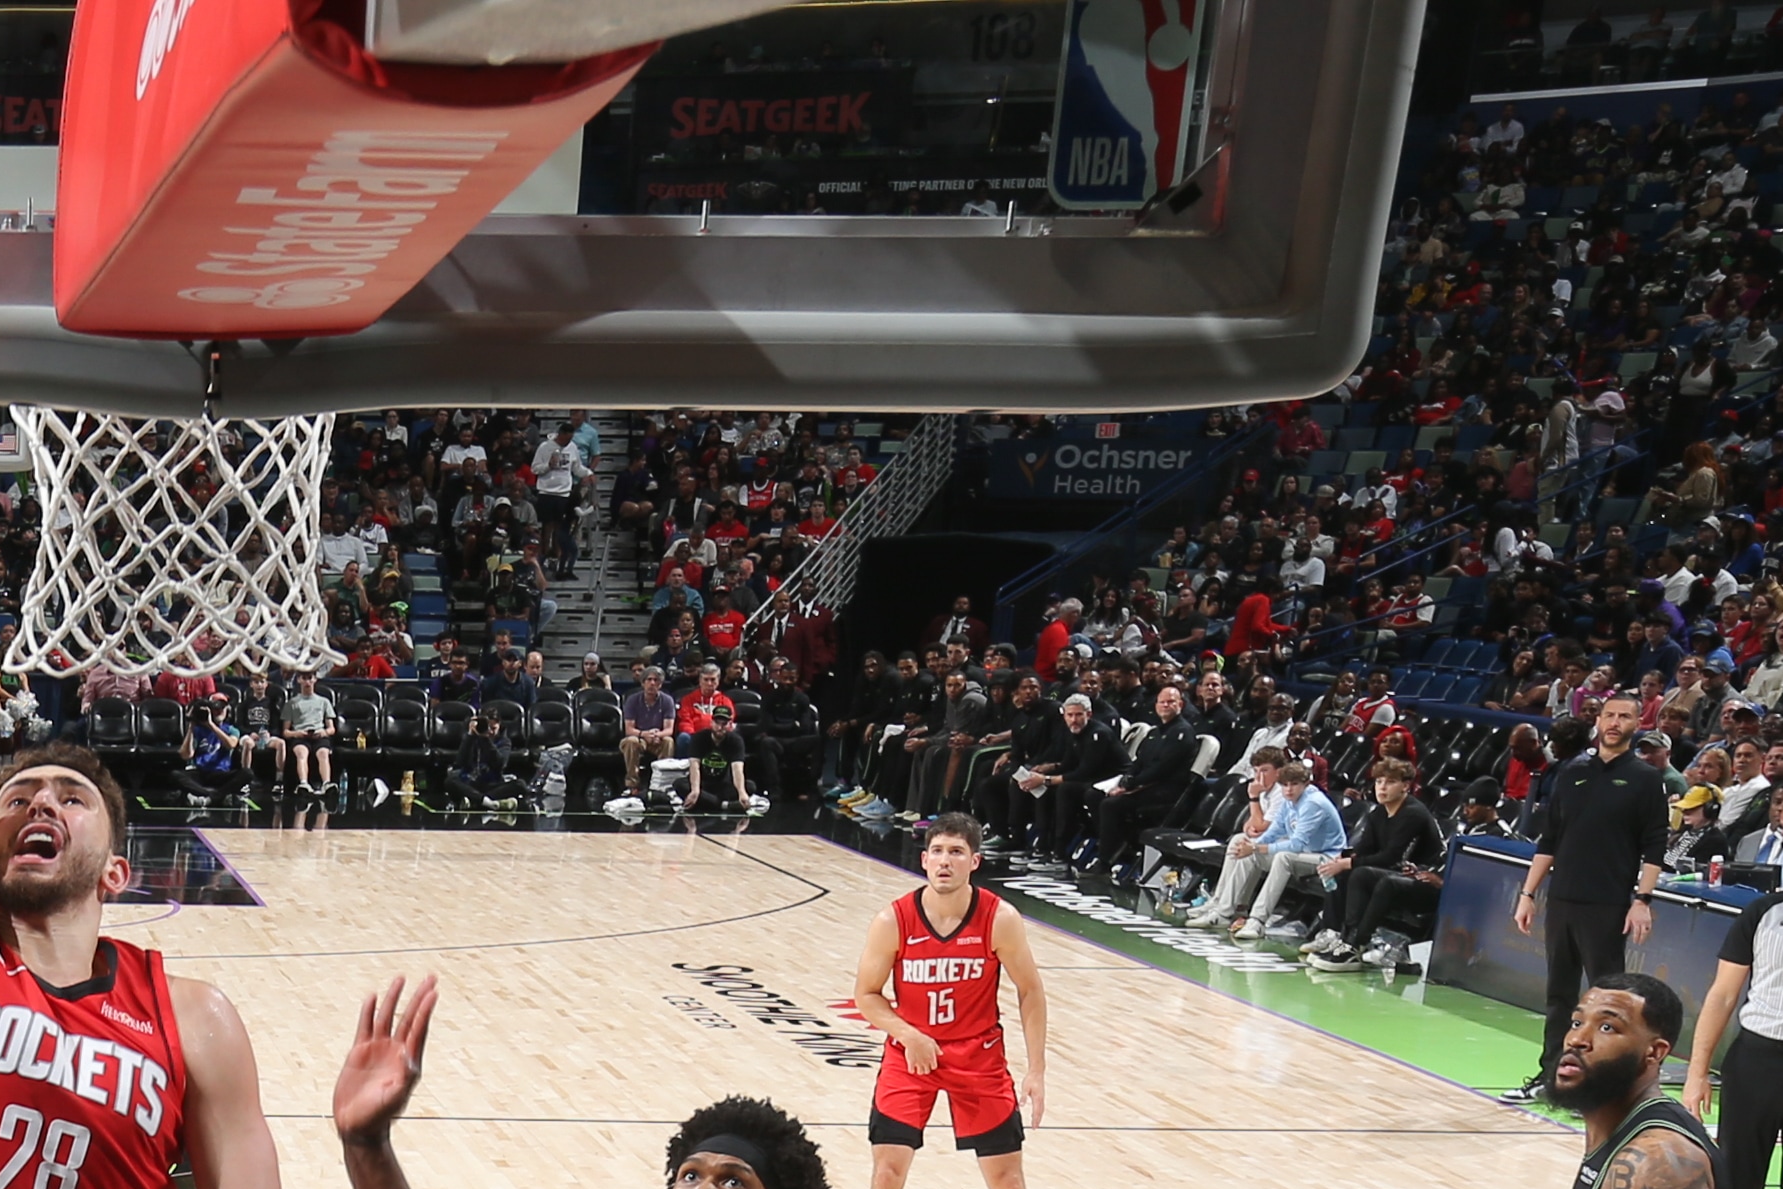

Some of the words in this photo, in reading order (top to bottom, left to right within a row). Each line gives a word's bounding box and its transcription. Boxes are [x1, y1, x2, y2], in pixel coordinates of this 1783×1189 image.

[670, 91, 873, 138] SEATGEEK
[1068, 136, 1129, 186] NBA
[919, 180, 968, 191] PARTNER
[1003, 178, 1025, 189] NEW
[1054, 444, 1192, 469] Ochsner
[1054, 474, 1141, 495] Health
[1003, 881, 1172, 927] Ochsner
[1122, 926, 1308, 972] Health
[902, 958, 985, 983] ROCKETS
[662, 995, 737, 1030] CENTER
[671, 963, 831, 1027] SMOOTHIE
[927, 988, 956, 1026] 15
